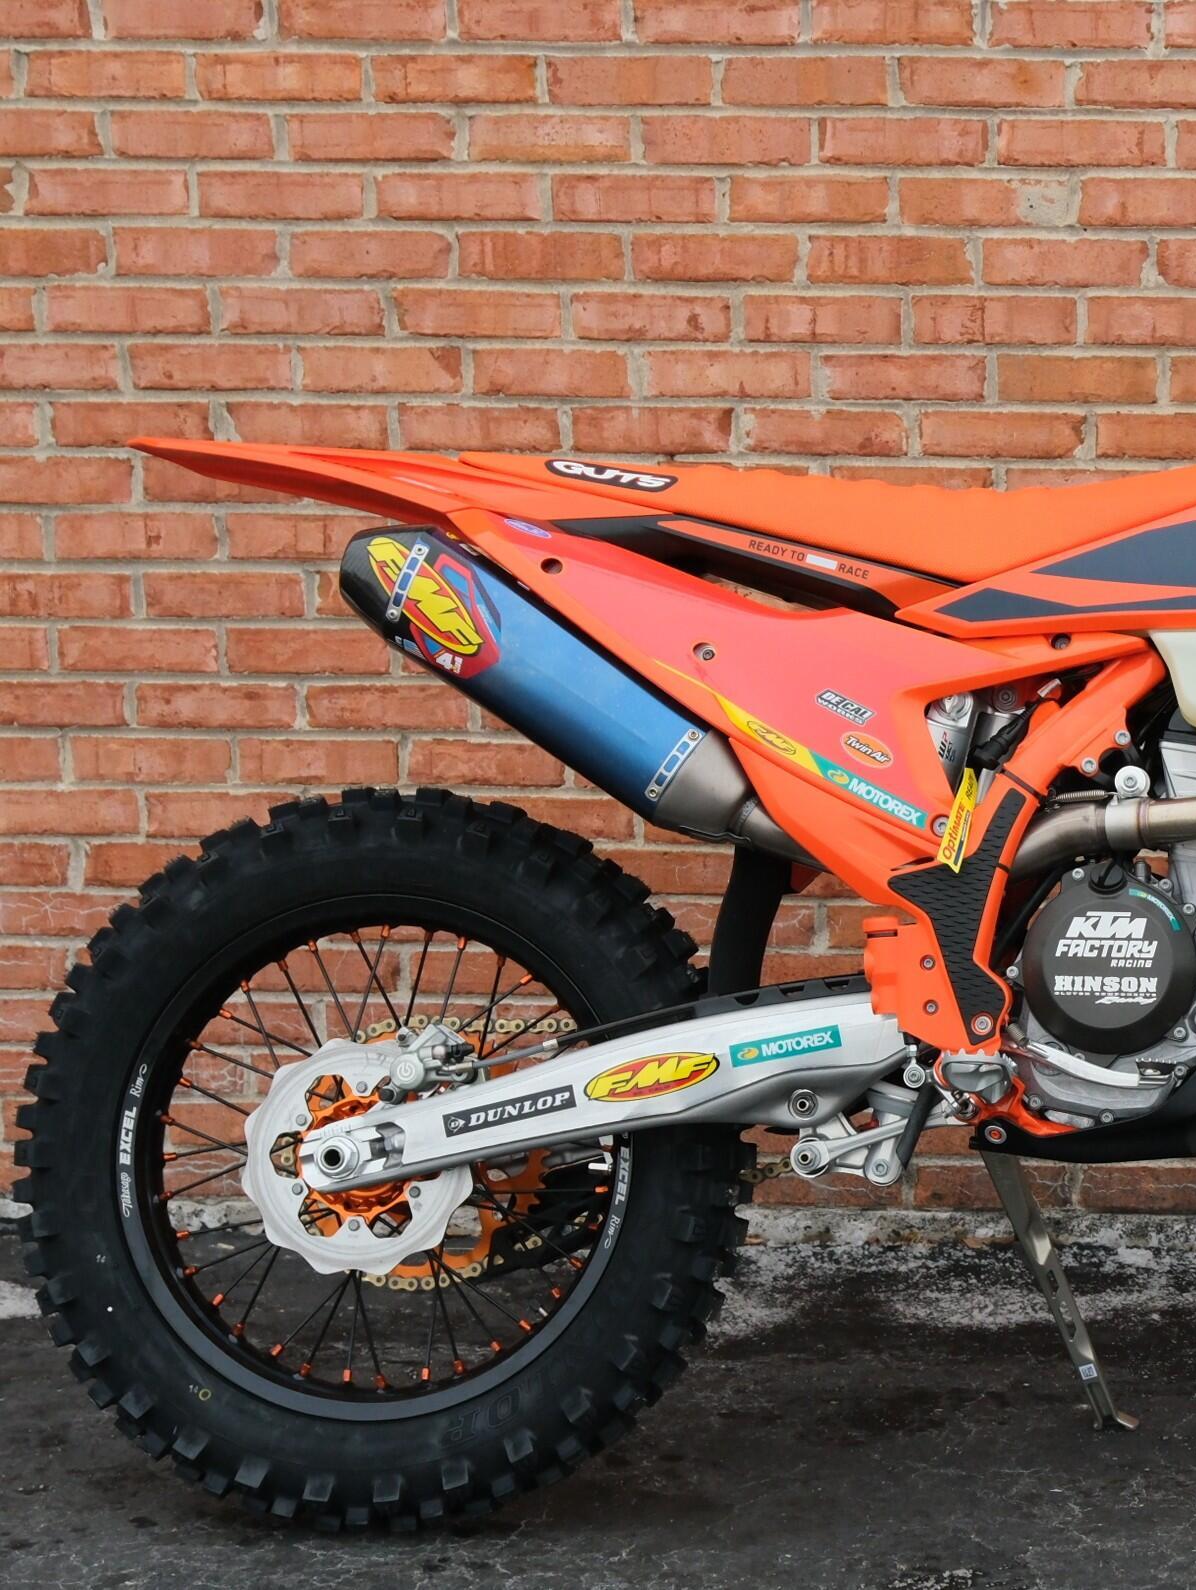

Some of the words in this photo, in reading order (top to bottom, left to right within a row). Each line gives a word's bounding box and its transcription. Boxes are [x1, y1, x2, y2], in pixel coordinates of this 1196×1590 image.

[552, 460, 671, 488] GUTS
[748, 539, 788, 558] READY
[790, 549, 805, 562] TO
[838, 563, 870, 580] RACE
[848, 777, 922, 826] MOTOREX
[1065, 911, 1148, 939] KTM
[1055, 939, 1158, 958] FACTORY
[1110, 959, 1153, 968] RACING
[1054, 975, 1158, 993] HINSON
[761, 1031, 834, 1057] MOTOREX
[588, 1053, 716, 1101] FMF
[119, 1106, 137, 1165] EXCEL
[129, 1063, 148, 1098] Rim
[468, 1091, 571, 1127] DUNLOP
[614, 1146, 630, 1205] EXCEL
